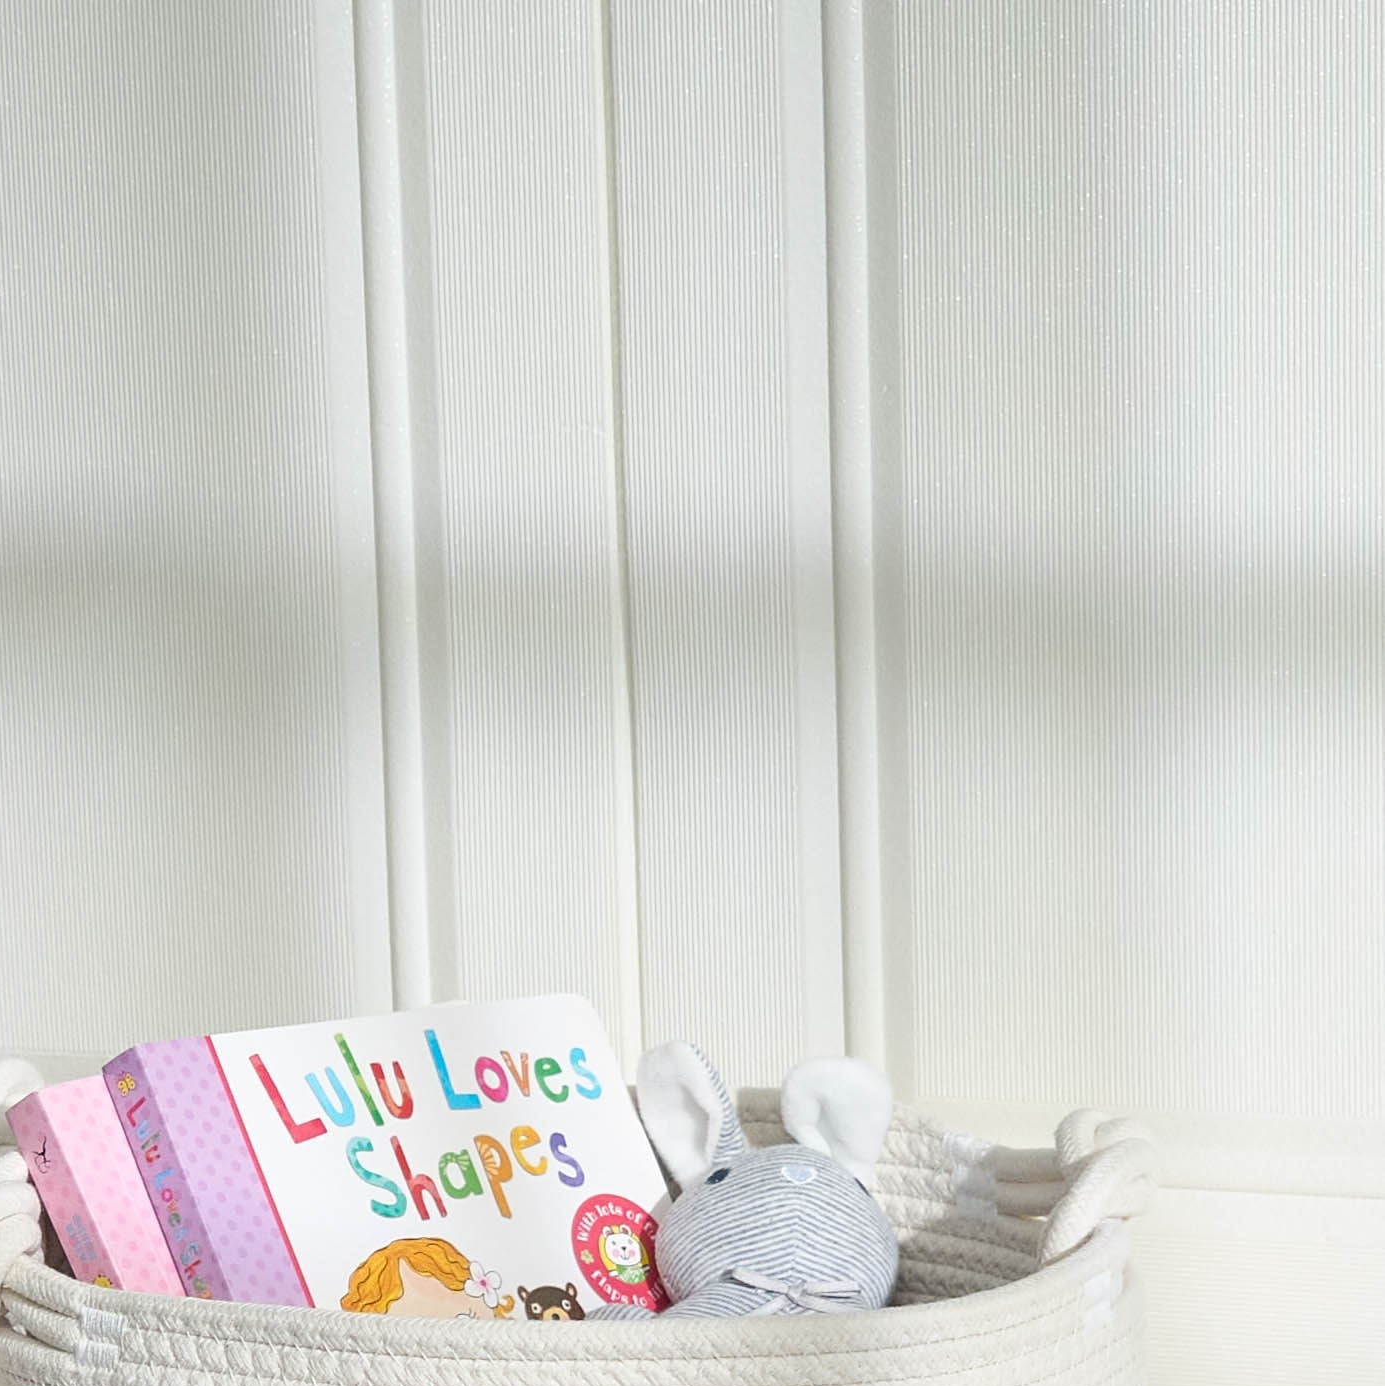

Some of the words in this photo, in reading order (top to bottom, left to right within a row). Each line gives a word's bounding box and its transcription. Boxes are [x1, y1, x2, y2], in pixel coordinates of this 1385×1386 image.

[249, 1033, 413, 1144] Lulu
[425, 1029, 602, 1110] Loves
[126, 1096, 162, 1163] Lulu
[153, 1167, 187, 1242] Loves
[346, 1126, 585, 1220] Shapes
[595, 1202, 623, 1217] lots
[625, 1210, 643, 1224] of
